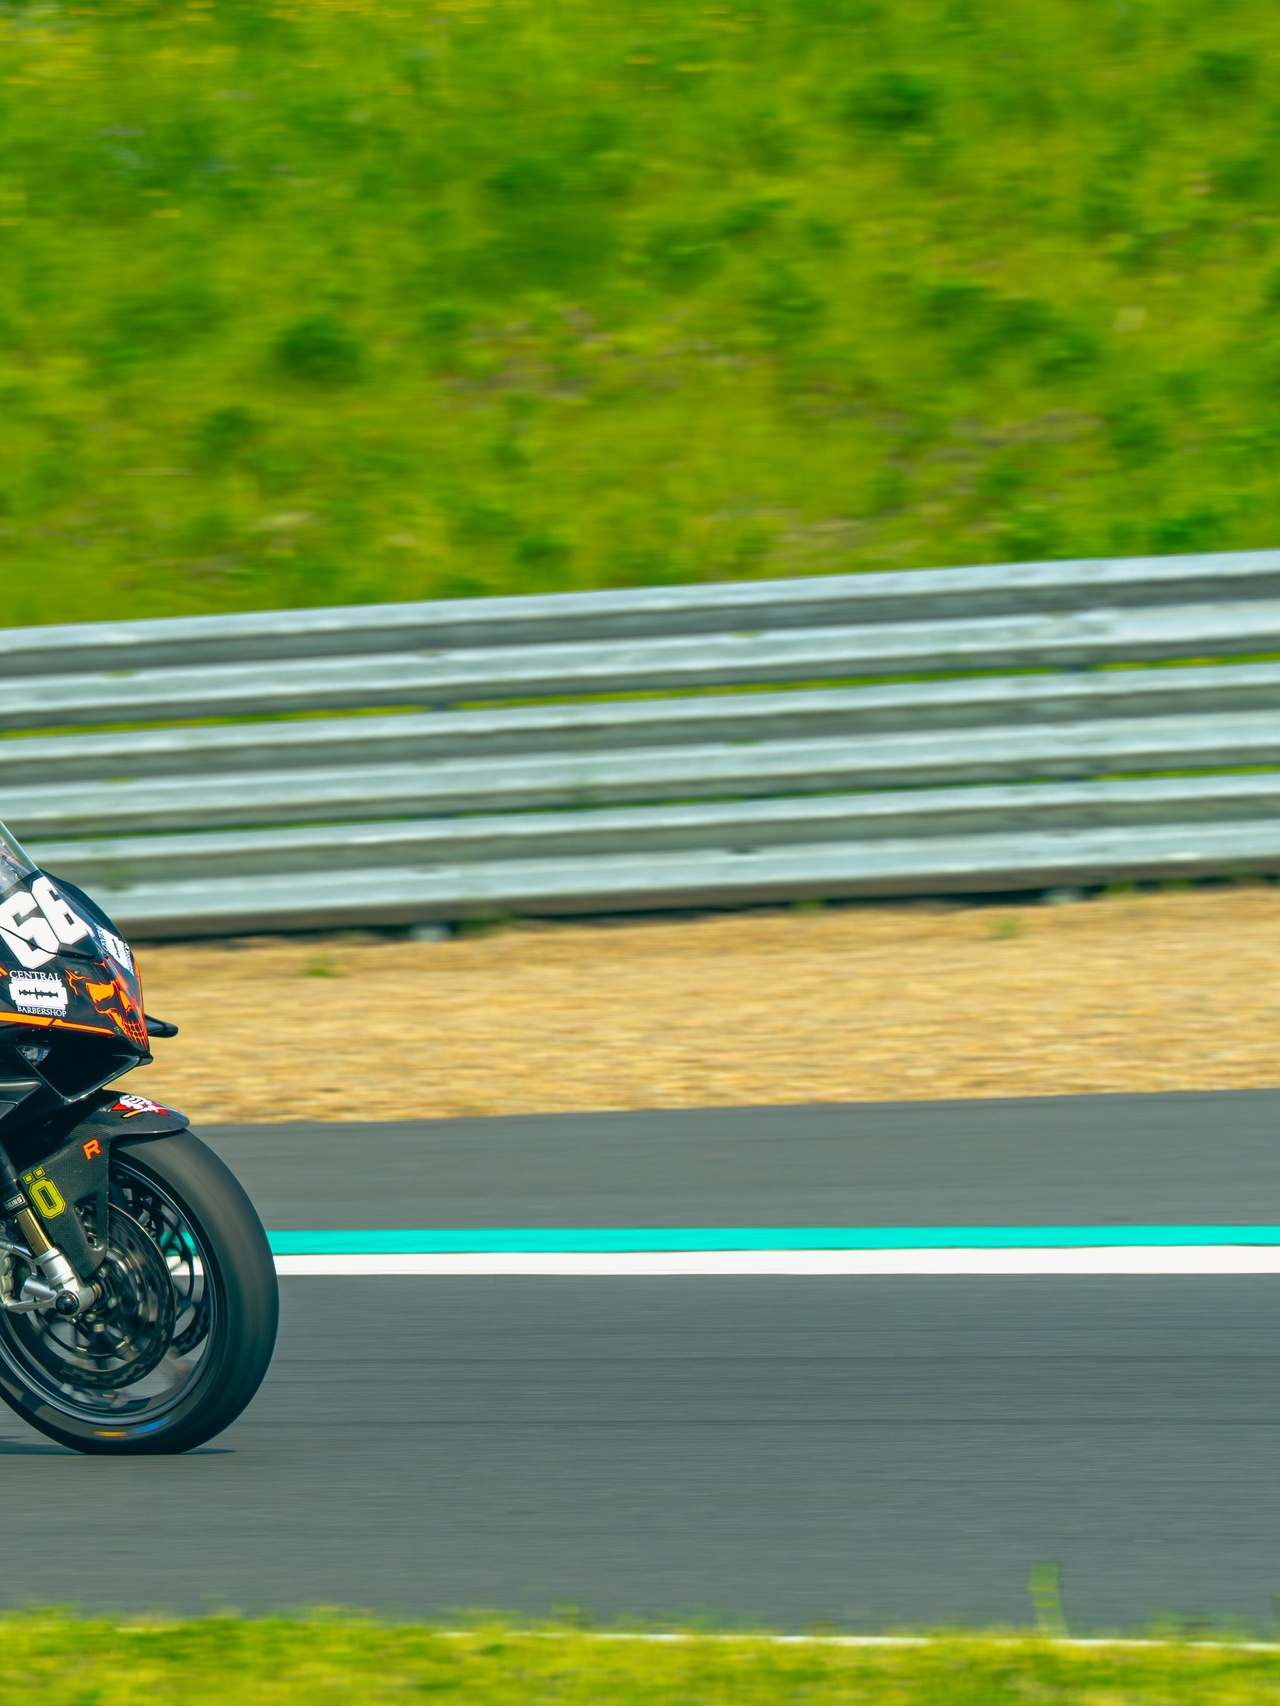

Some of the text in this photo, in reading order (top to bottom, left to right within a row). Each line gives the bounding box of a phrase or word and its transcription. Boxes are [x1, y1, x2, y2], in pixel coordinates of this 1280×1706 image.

[9, 970, 62, 981] CENTRAL
[17, 1005, 67, 1018] BARBERSHOP
[82, 1138, 102, 1160] R
